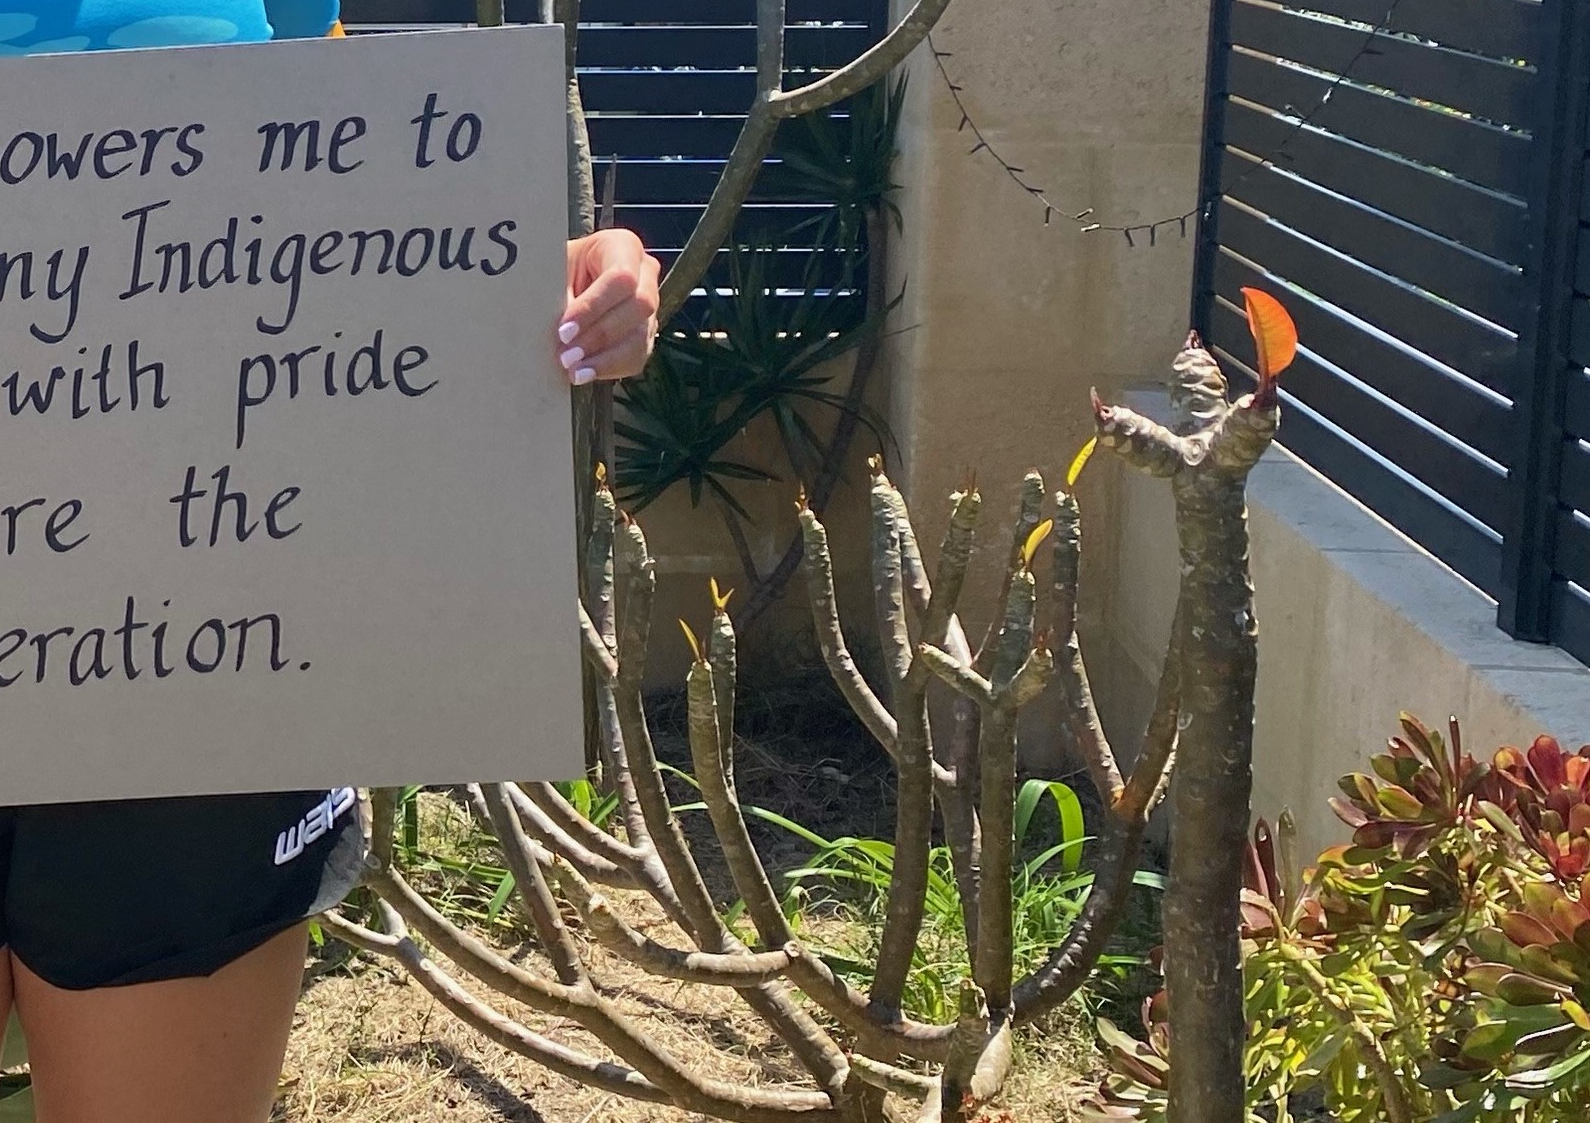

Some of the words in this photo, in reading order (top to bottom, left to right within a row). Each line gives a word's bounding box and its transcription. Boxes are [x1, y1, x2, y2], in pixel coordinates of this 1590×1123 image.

[258, 117, 367, 175] me
[411, 93, 482, 169] to
[119, 200, 518, 335] Indigenous
[2, 340, 171, 420] with
[236, 329, 439, 450] pride
[169, 465, 303, 549] the
